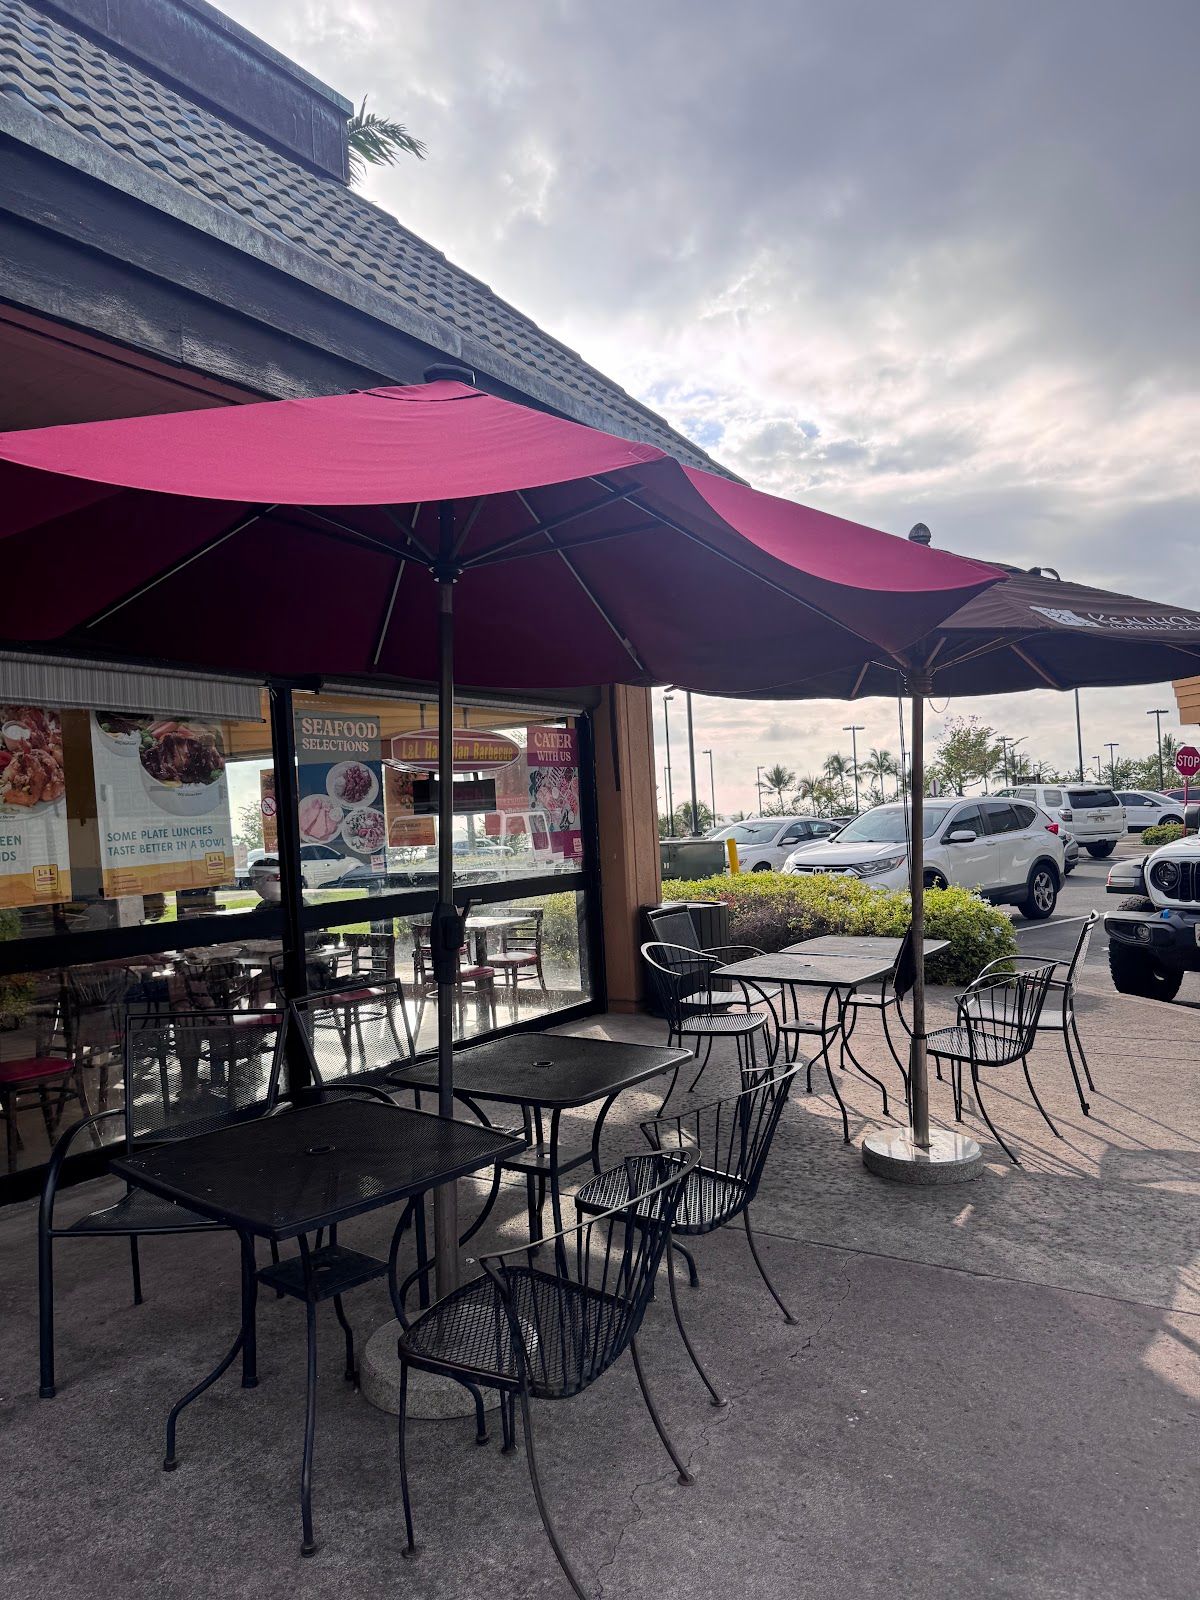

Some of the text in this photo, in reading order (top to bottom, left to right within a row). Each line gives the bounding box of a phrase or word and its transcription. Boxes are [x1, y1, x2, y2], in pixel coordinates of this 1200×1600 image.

[302, 718, 378, 738] SEAFOOD
[302, 738, 369, 752] SELECTIONS
[534, 732, 573, 748] CATER
[402, 741, 513, 761] L&L Haian Barbecue
[537, 751, 571, 761] WITH US
[1177, 755, 1200, 767] STOP
[107, 826, 213, 842] SOME PLATE LUNCHES
[108, 838, 226, 856] TASTE BETTER IN A BOWL
